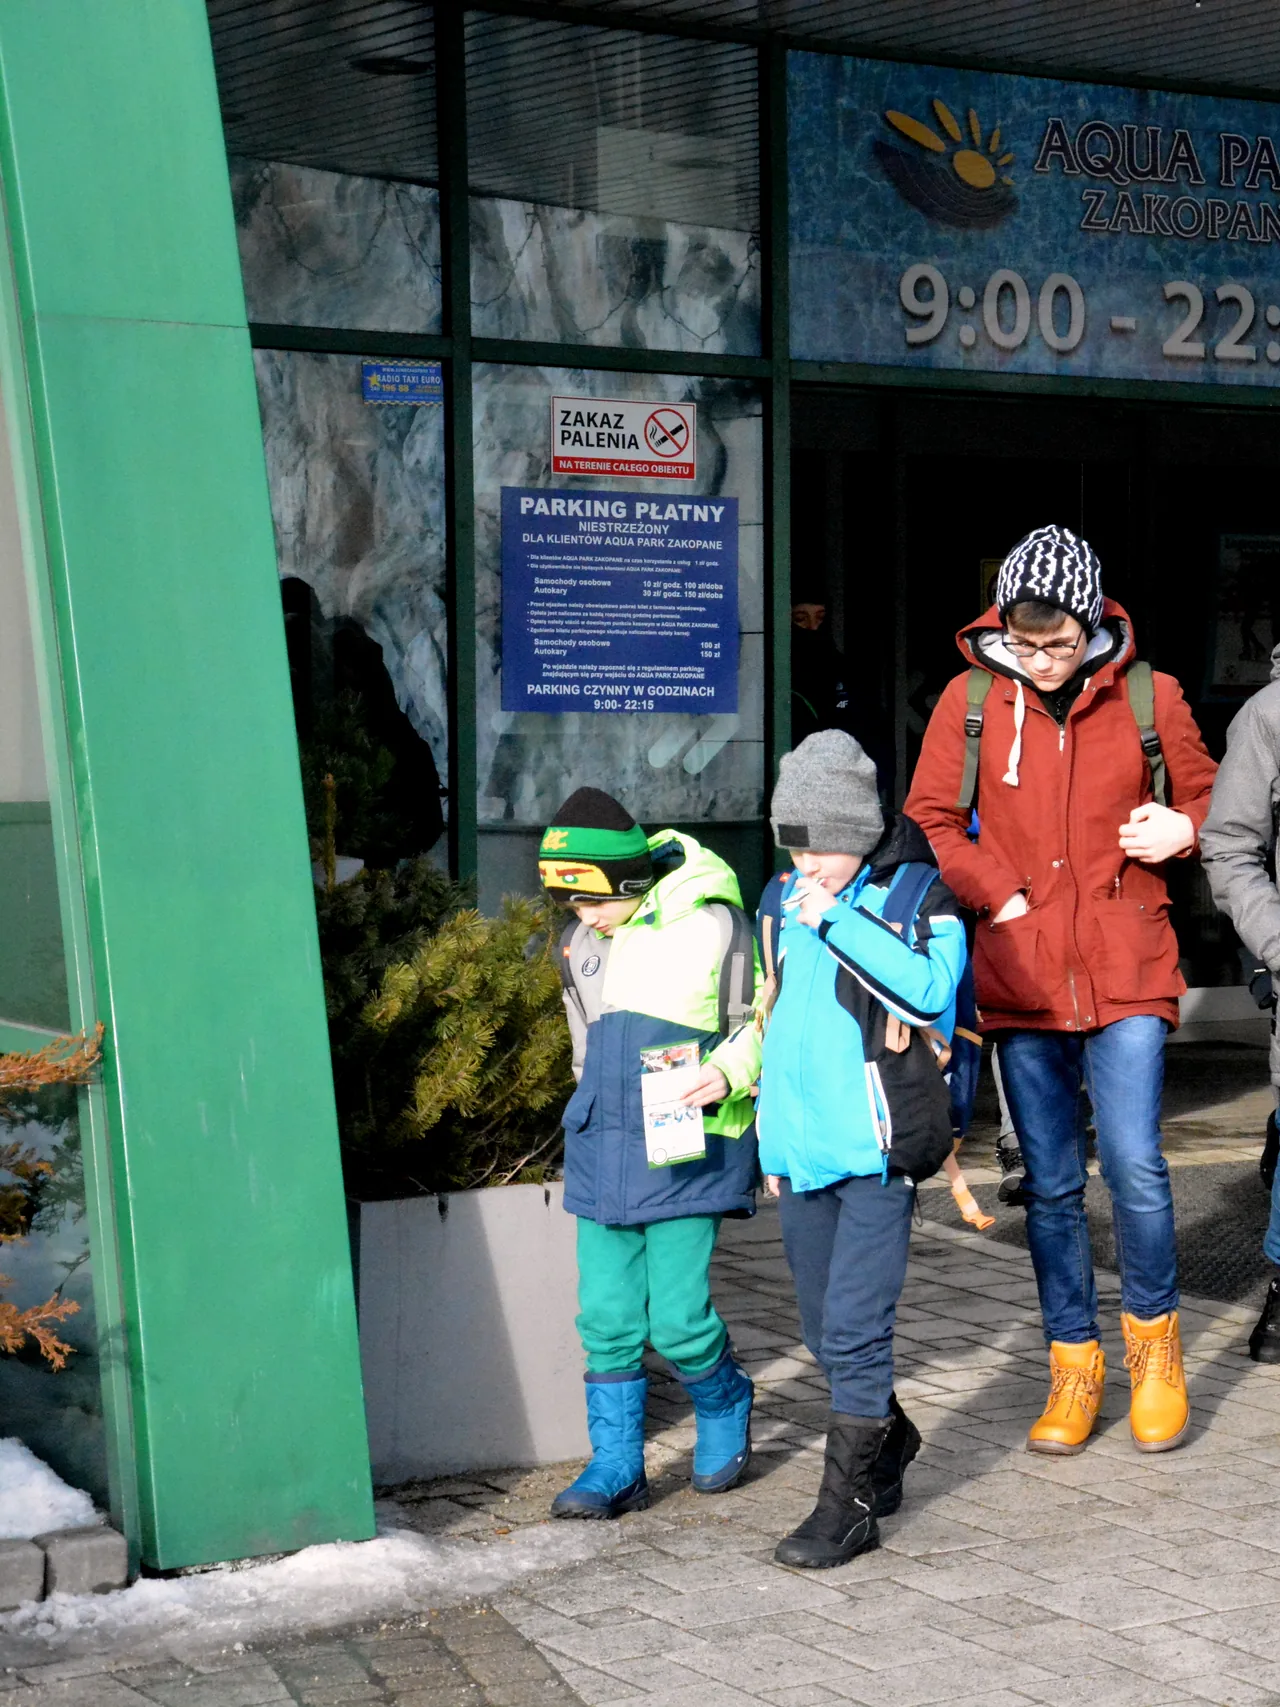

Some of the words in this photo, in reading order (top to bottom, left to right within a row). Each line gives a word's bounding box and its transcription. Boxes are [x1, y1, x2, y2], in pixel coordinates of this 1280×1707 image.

[1034, 117, 1206, 186] AQUA
[899, 263, 1086, 352] 9:00
[1110, 315, 1137, 331] -
[421, 376, 441, 384] EURO
[560, 410, 624, 429] ZAKAZ
[560, 430, 640, 450] PALENIA
[560, 460, 573, 469] NA
[574, 461, 611, 471] TERENIE
[612, 462, 650, 472] CAŁEGO
[651, 465, 690, 474] OBIEKTU
[520, 497, 627, 518] PARKING
[635, 502, 725, 522] PŁATNY
[578, 522, 669, 534] NIESTRZEŻONY
[522, 533, 544, 543] DLA
[547, 534, 602, 545] KLIENTÓW
[604, 537, 634, 546] AQUA
[637, 538, 665, 548] PARK
[668, 539, 722, 550] ZAKOPANE
[534, 577, 577, 586] Samochody
[663, 582, 682, 590] godz.
[534, 587, 568, 595] Autokary
[663, 591, 682, 599] godz.
[534, 638, 577, 648] Samochody
[534, 648, 567, 656] Autokary
[527, 684, 580, 695] PARKING
[583, 684, 630, 696] CZYNNY
[633, 686, 644, 695] W
[647, 686, 715, 696] GODZINACH
[594, 699, 621, 710] 9:00-
[624, 700, 654, 710] 22:15
